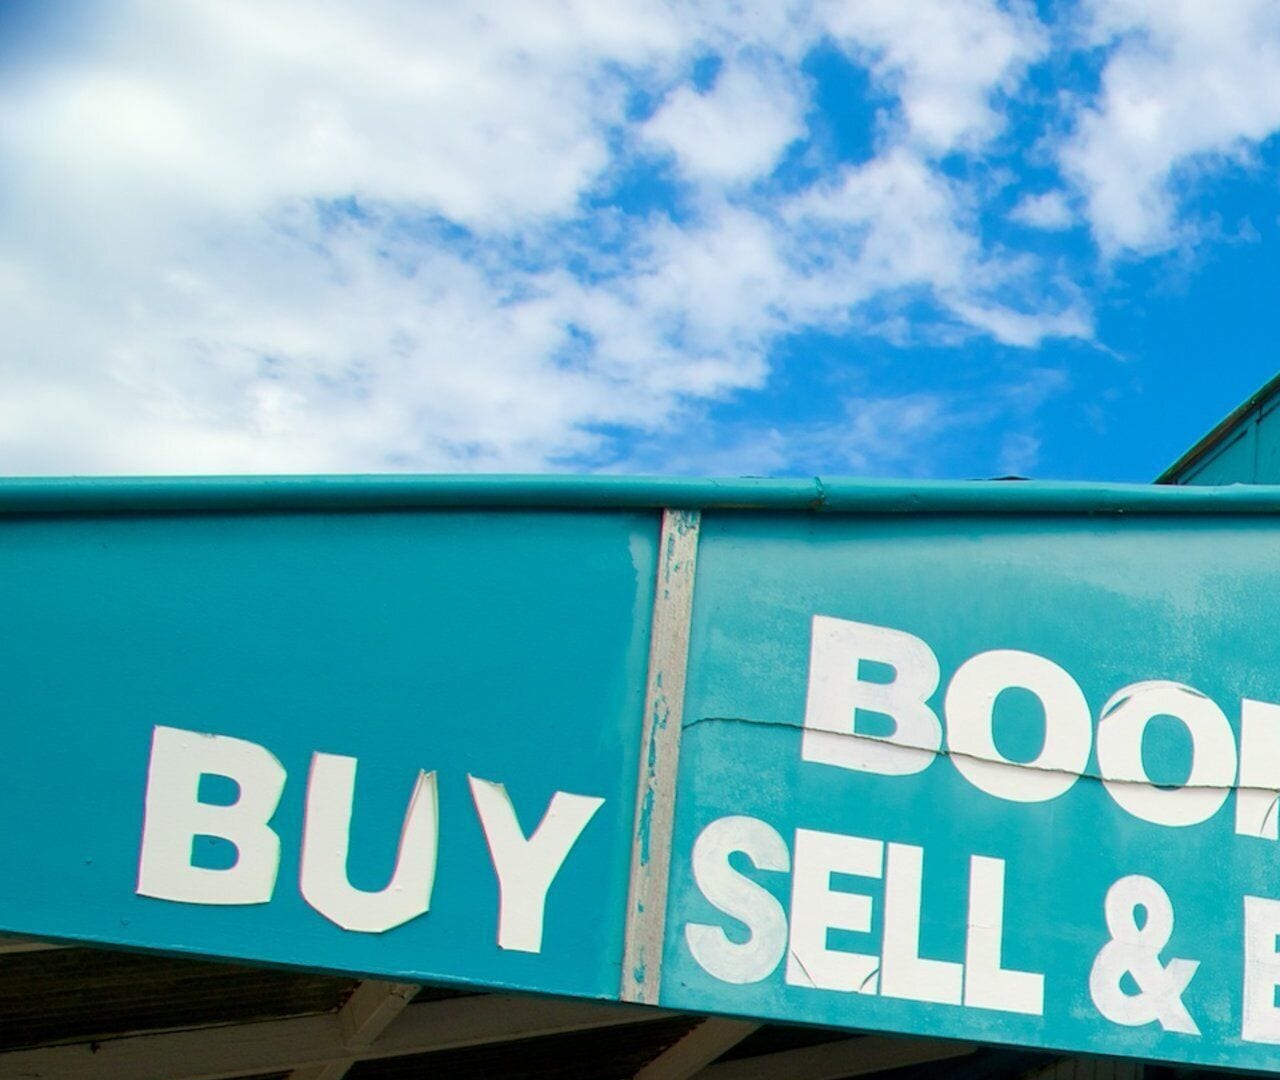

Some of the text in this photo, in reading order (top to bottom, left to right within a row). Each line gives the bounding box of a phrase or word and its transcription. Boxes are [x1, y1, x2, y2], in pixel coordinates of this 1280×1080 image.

[136, 724, 605, 954] BUY
[685, 815, 1045, 1018] SELL
[1091, 875, 1201, 1037] &
